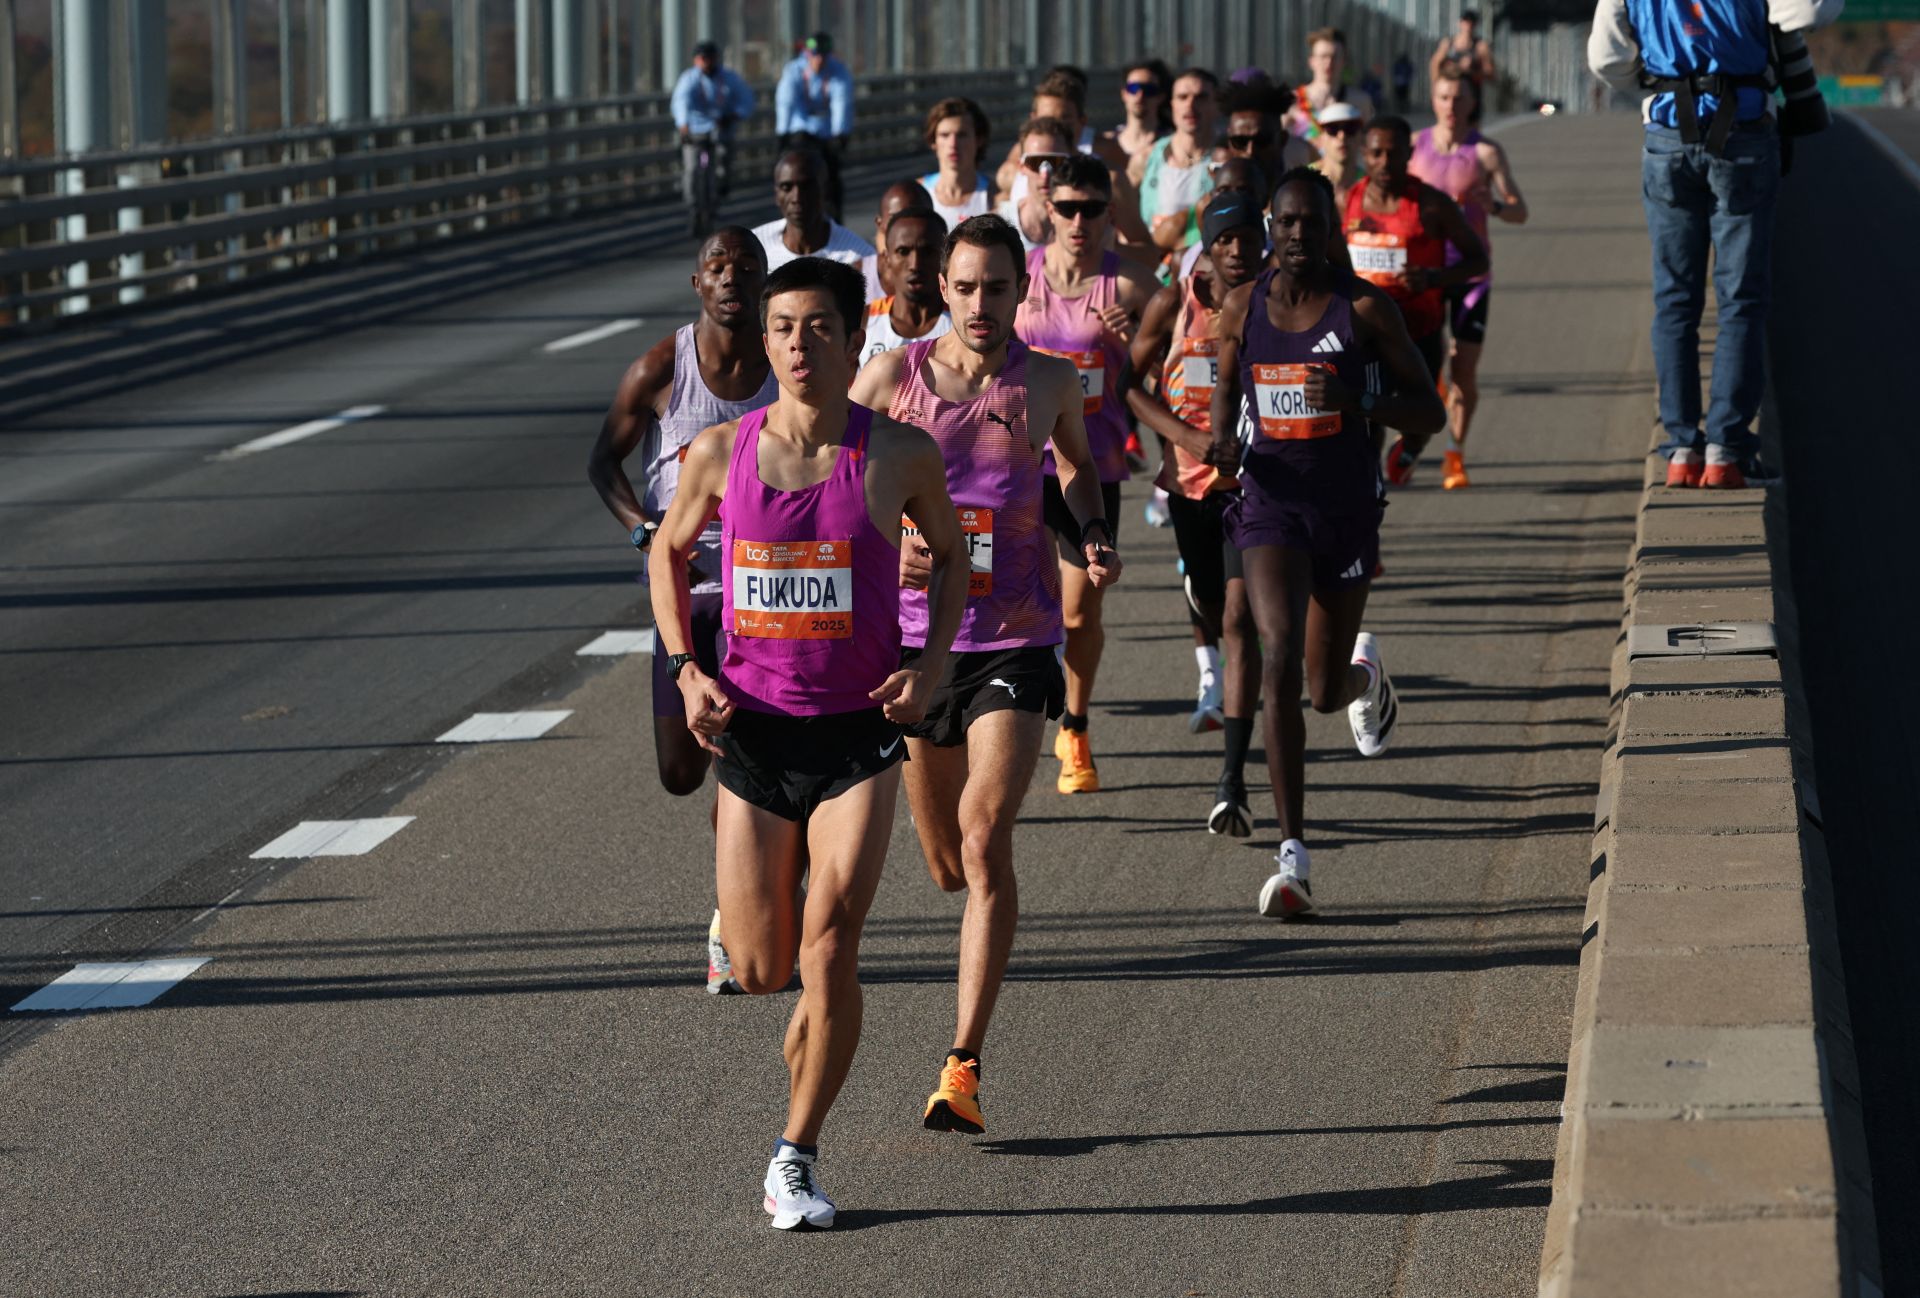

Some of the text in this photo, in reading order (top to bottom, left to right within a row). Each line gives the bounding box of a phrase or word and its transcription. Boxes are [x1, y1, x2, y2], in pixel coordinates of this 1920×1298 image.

[1260, 366, 1278, 380] tcs
[1271, 391, 1320, 415] KOR
[746, 545, 769, 562] tcs
[747, 575, 838, 608] FUKUDA
[811, 620, 846, 631] 2025
